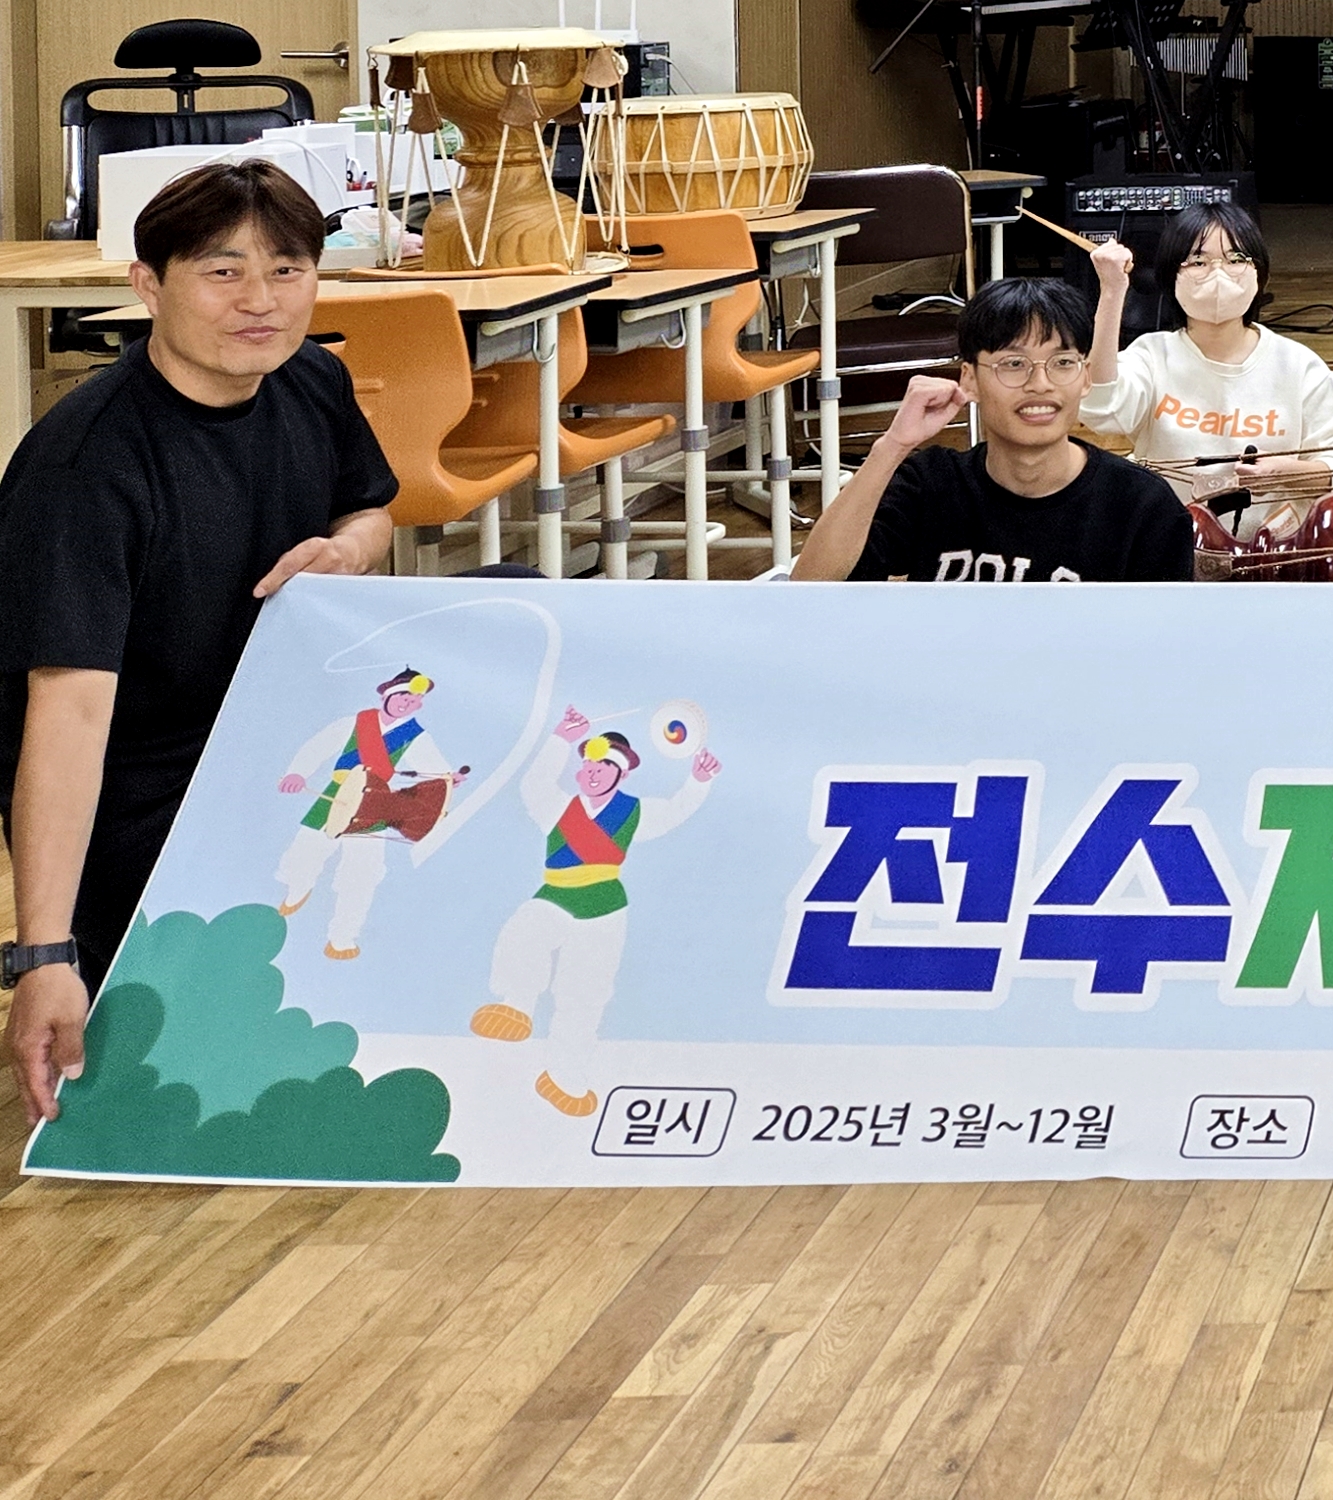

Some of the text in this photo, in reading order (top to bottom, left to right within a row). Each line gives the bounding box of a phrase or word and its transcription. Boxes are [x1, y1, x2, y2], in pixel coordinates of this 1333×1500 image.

[624, 1097, 712, 1146] 일시
[752, 1102, 1115, 1150] 2025년 3월~12월
[1205, 1106, 1289, 1150] 장소
